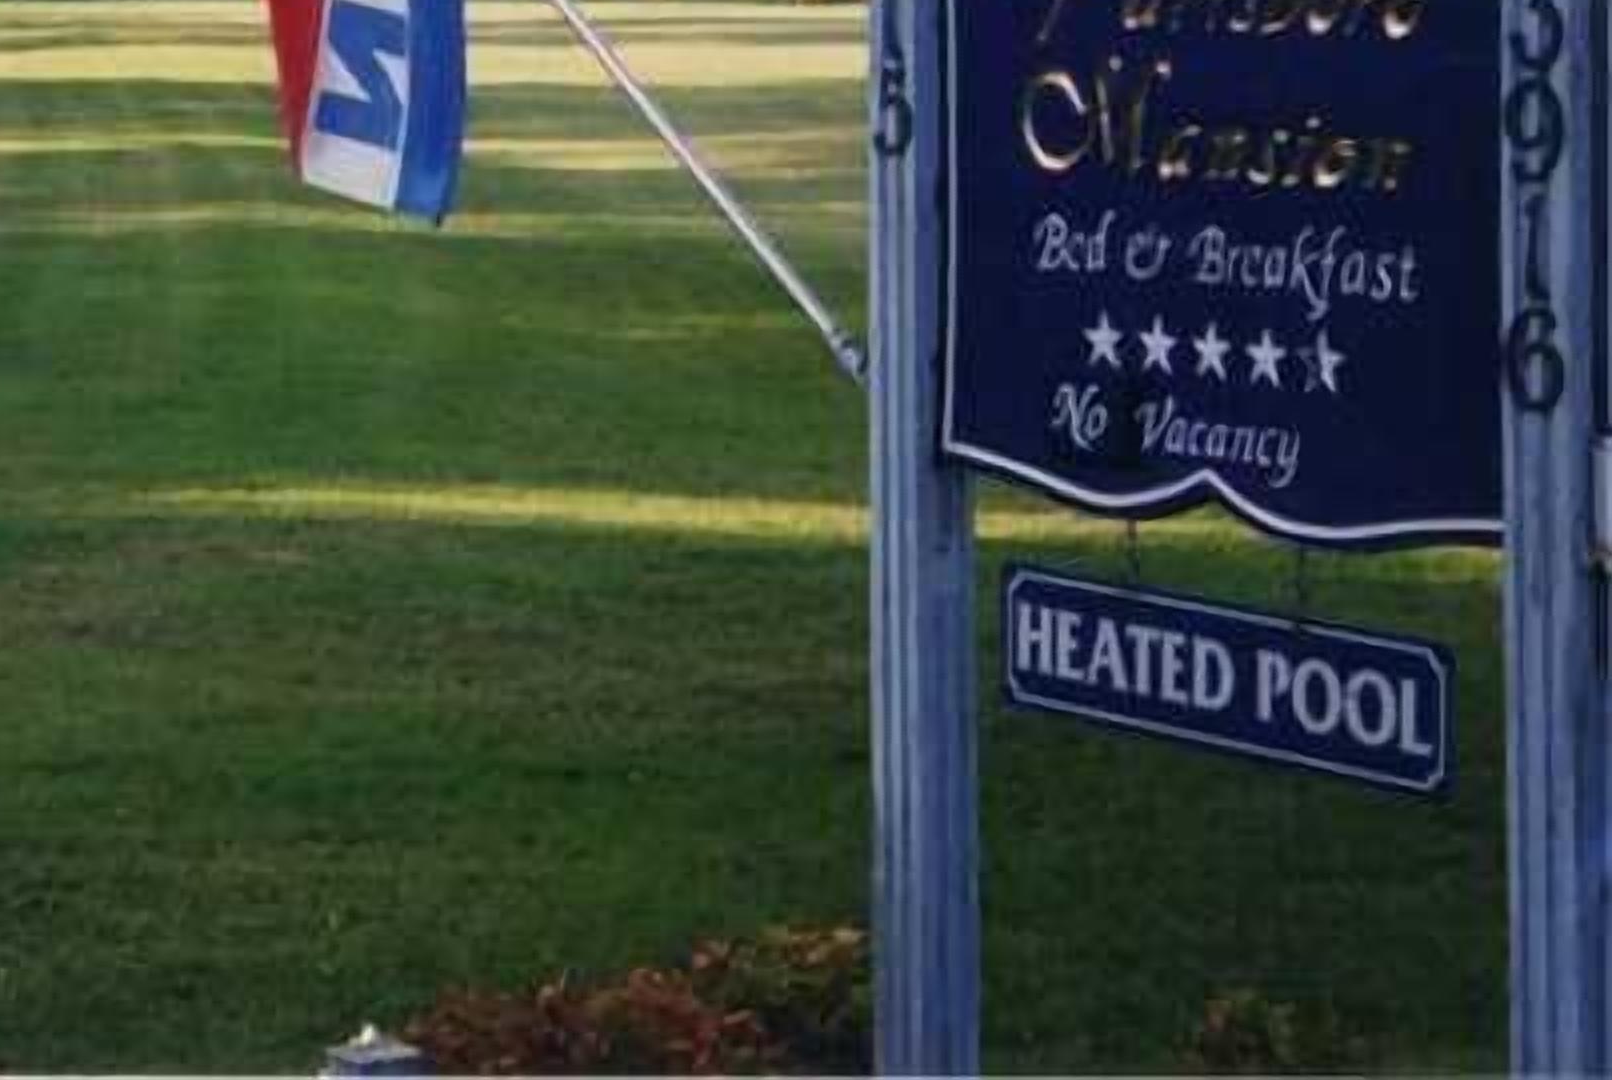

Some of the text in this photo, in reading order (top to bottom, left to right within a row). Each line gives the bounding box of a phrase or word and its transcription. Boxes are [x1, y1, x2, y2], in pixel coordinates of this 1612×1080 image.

[1022, 53, 1410, 191] Mansion
[1033, 210, 1421, 320] Bed & Breakfast
[1049, 381, 1302, 489] No Vacancy
[1015, 602, 1434, 757] HEATED POOL
